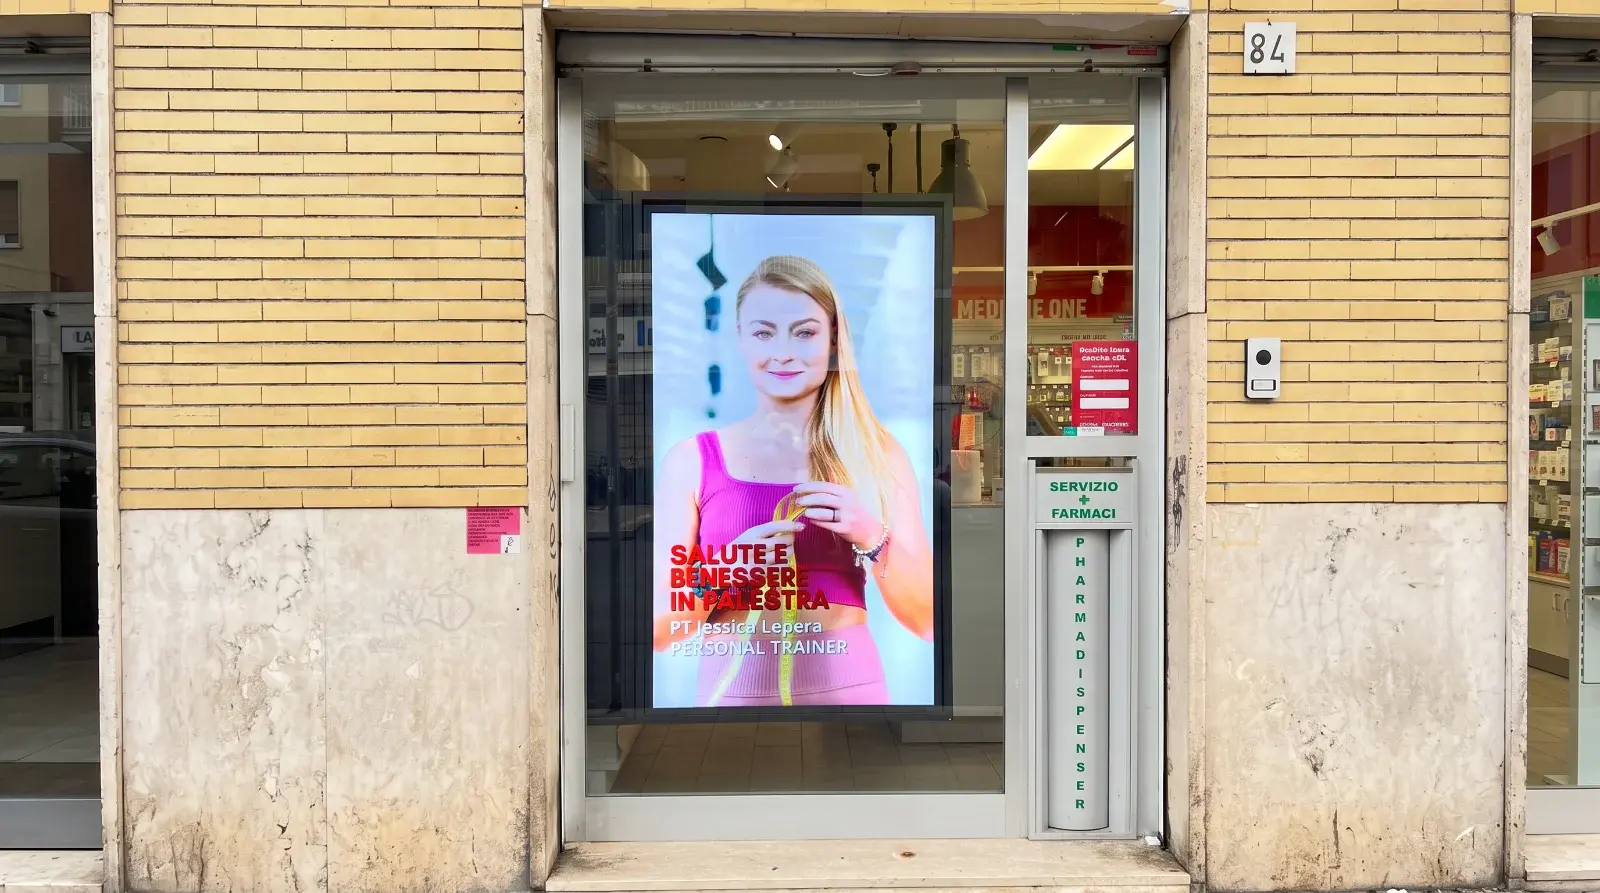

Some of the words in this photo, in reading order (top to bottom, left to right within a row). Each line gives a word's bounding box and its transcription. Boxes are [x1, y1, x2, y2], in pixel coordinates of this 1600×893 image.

[1250, 33, 1285, 64] 84
[1049, 299, 1087, 320] ONE
[1050, 481, 1119, 492] SERVIZIO
[1051, 508, 1116, 519] FARMACI
[671, 544, 767, 566] SALUTE
[775, 543, 789, 565] E
[670, 567, 809, 589] BENESSERE
[670, 591, 696, 612] IN
[703, 589, 831, 612] PALESTRA
[670, 620, 692, 636] PT
[696, 618, 757, 638] Jessica
[762, 620, 823, 638] Lepera
[671, 641, 766, 657] PERSONAL
[770, 640, 849, 656] TRAINER
[1075, 537, 1086, 809] PHARMADISPENSER
